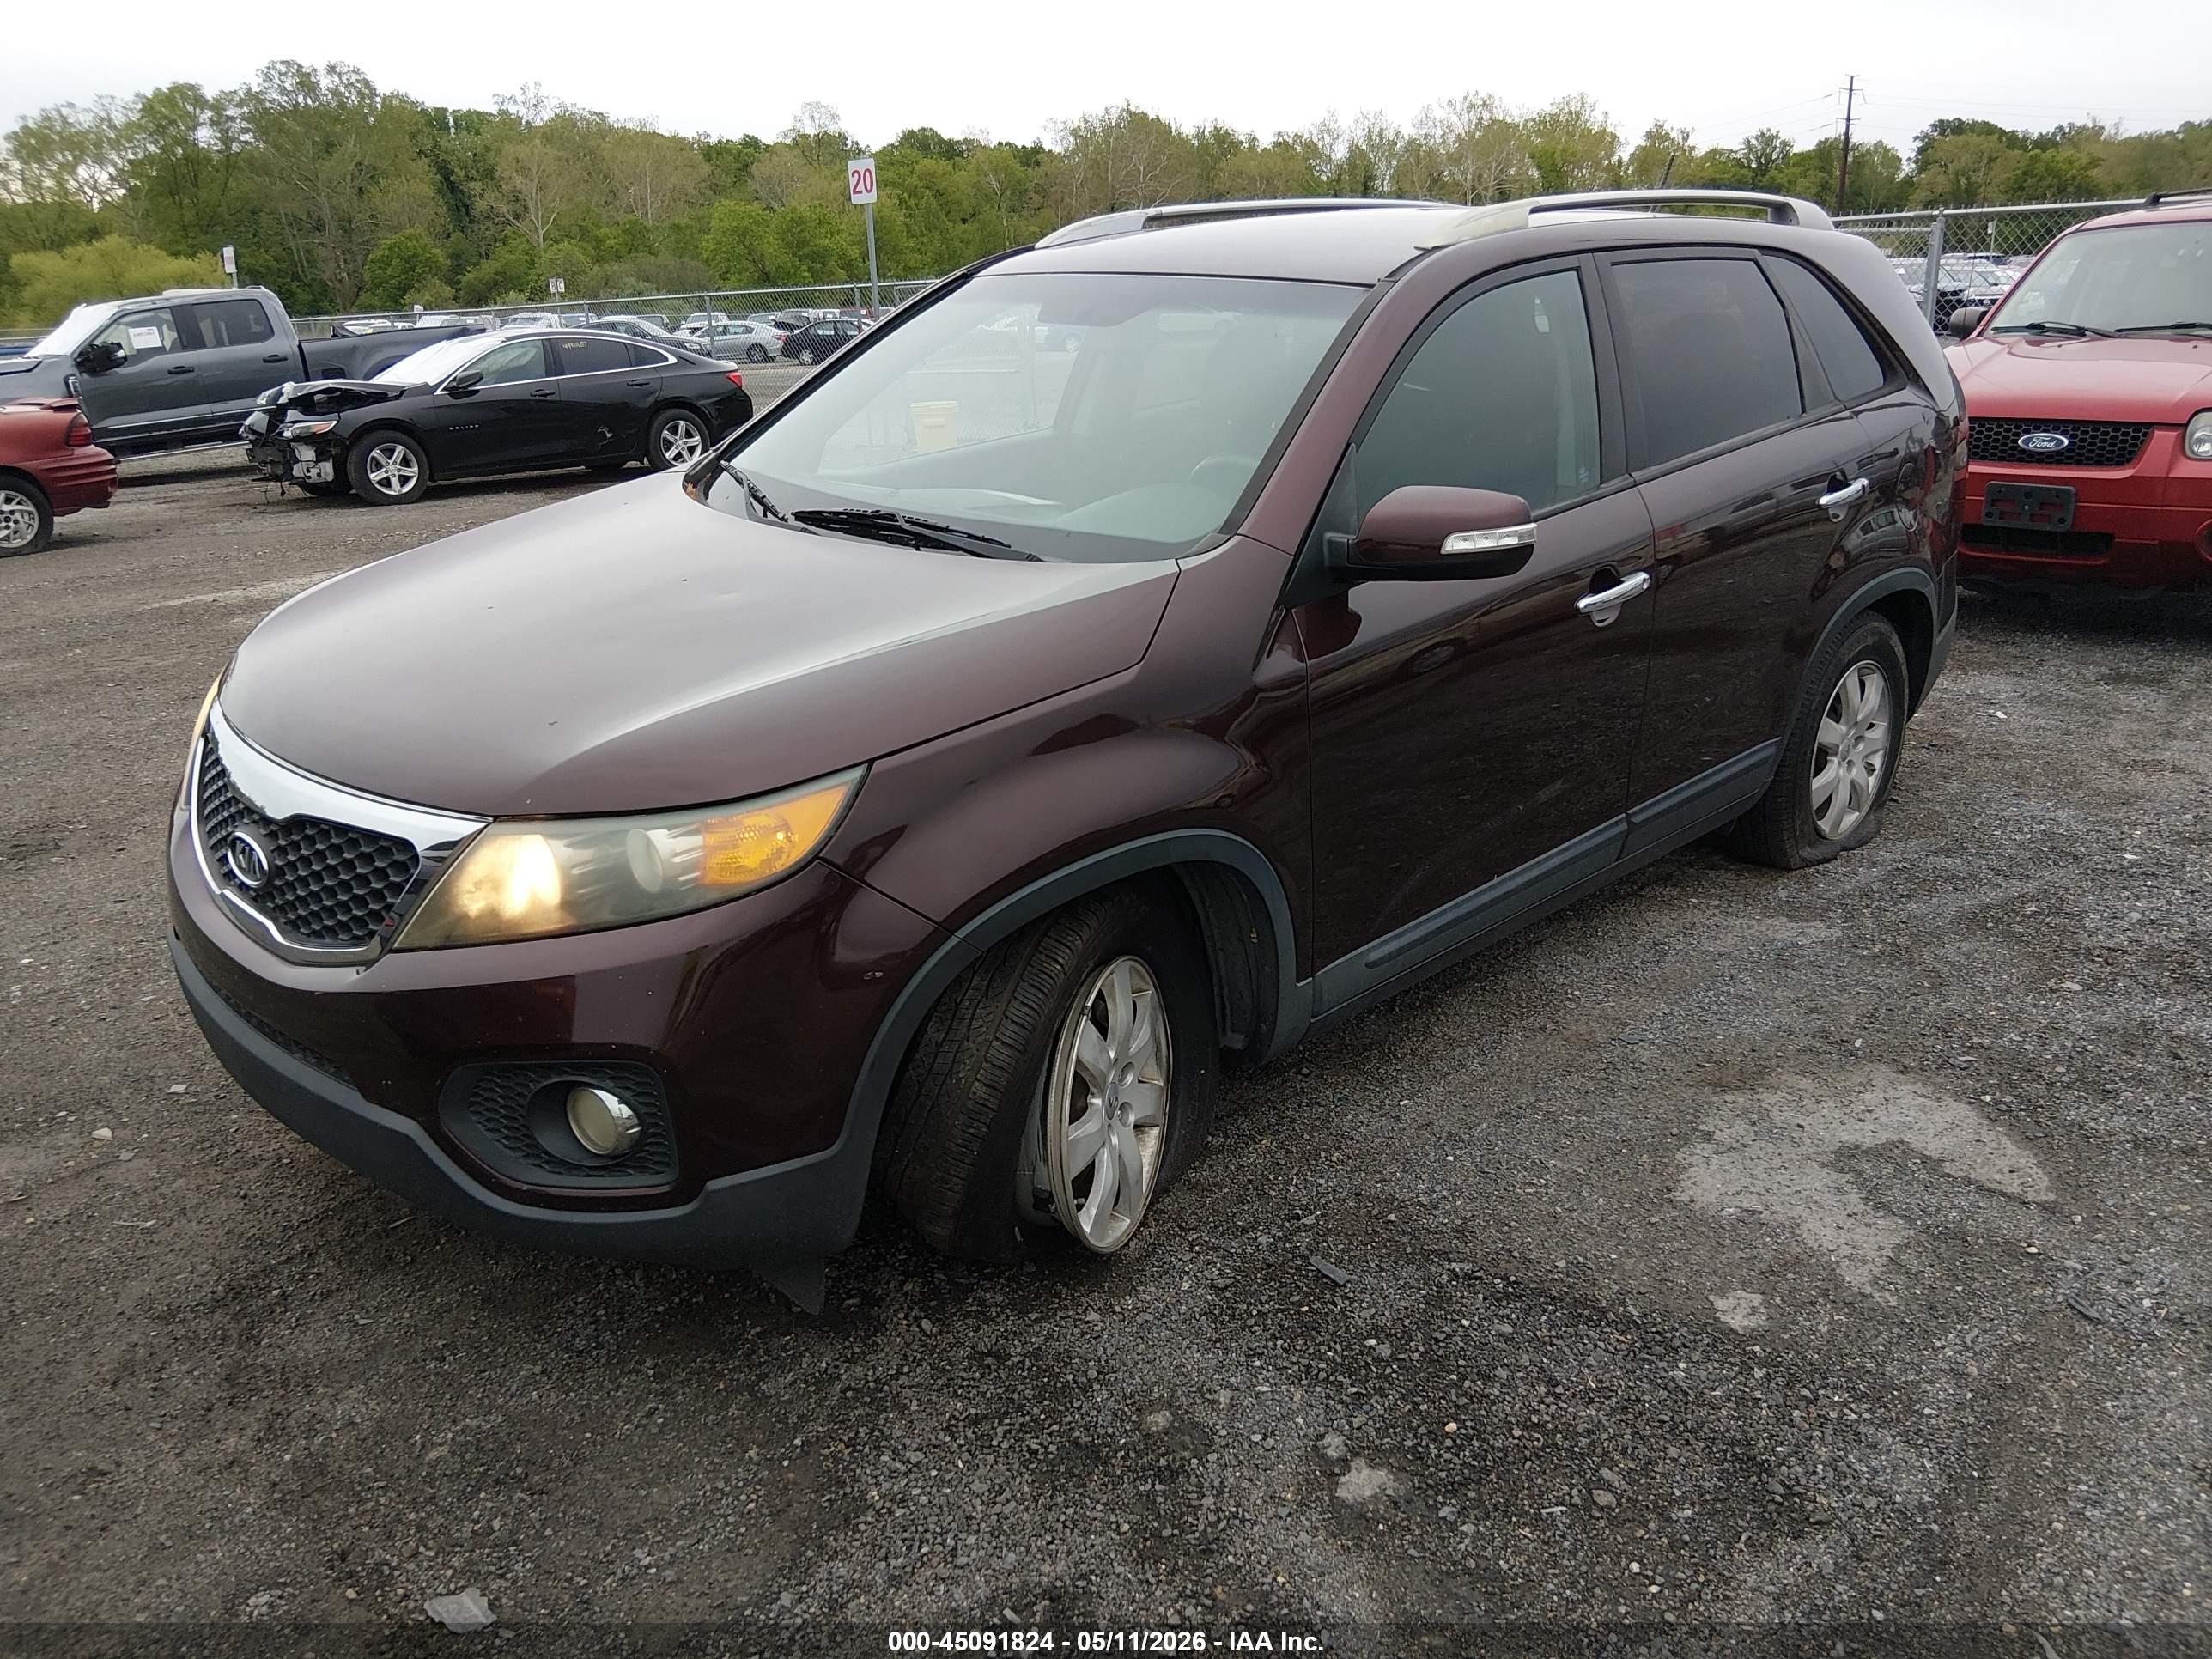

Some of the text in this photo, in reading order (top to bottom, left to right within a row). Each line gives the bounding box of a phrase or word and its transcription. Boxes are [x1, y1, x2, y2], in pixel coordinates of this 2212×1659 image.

[851, 167, 874, 195] 20
[2028, 436, 2057, 448] Ford
[235, 839, 262, 879] KIA
